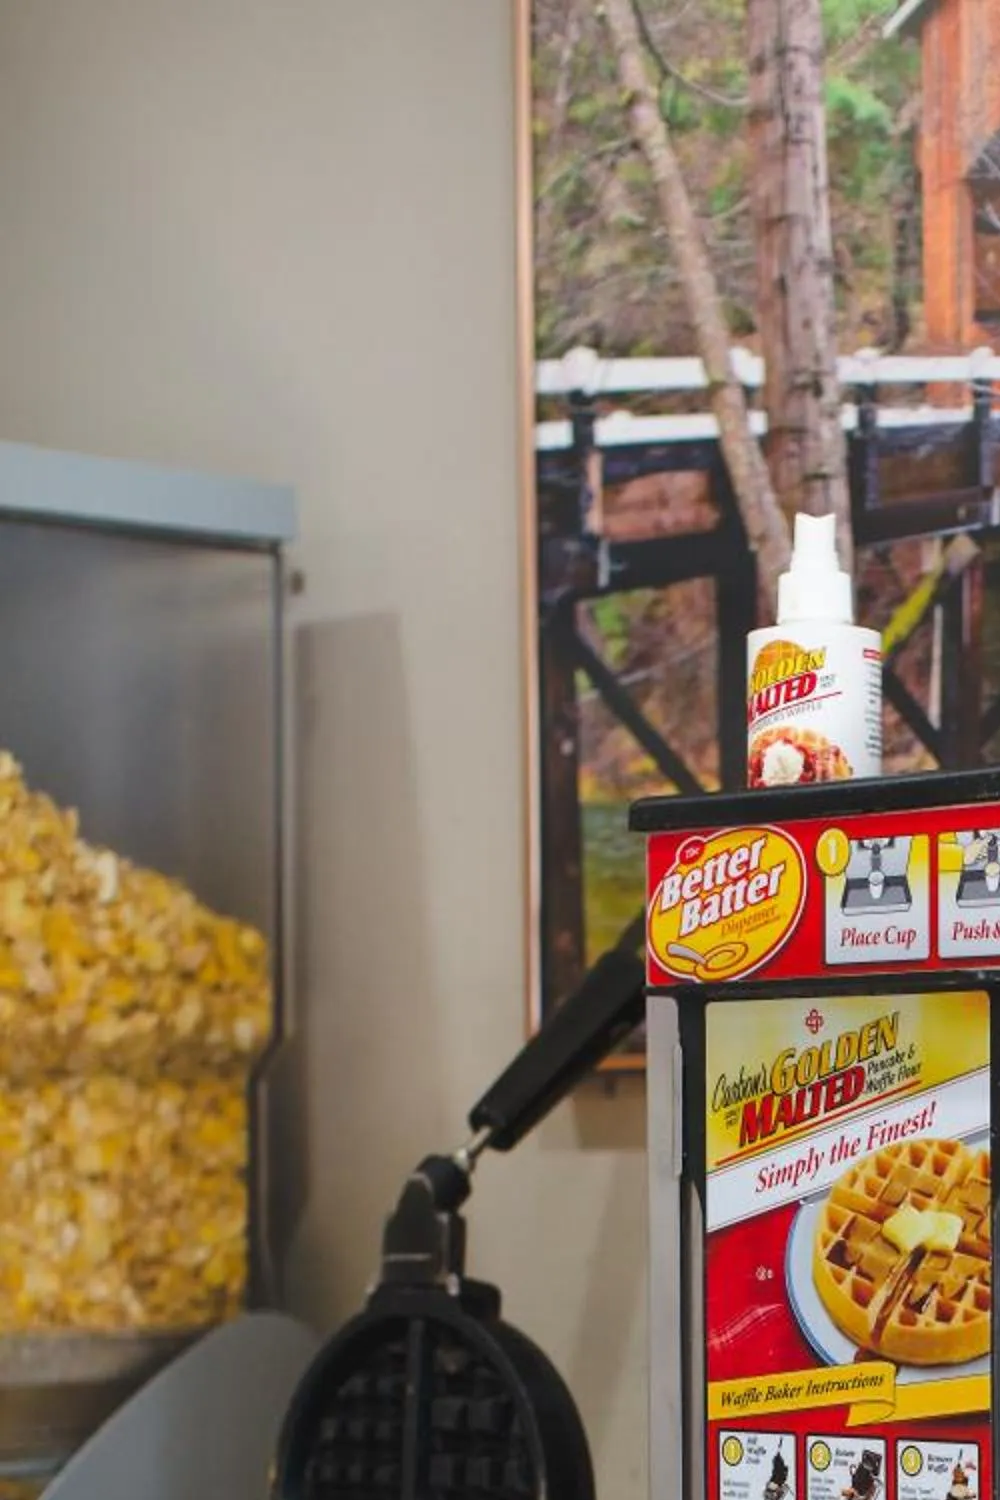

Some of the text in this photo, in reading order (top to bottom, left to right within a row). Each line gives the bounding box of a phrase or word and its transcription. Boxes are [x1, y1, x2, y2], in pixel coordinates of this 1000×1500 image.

[660, 834, 767, 913] Better
[828, 842, 839, 864] 1
[680, 861, 785, 938] Batter
[721, 906, 776, 938] Dispenser
[840, 926, 917, 948] Place Cup
[951, 920, 993, 942] Push
[769, 1011, 900, 1096] GOLDEN
[738, 1065, 867, 1148] MALTED
[755, 1101, 937, 1193] Simply the Finest!
[721, 1373, 885, 1409] Waffle Baker Instructions
